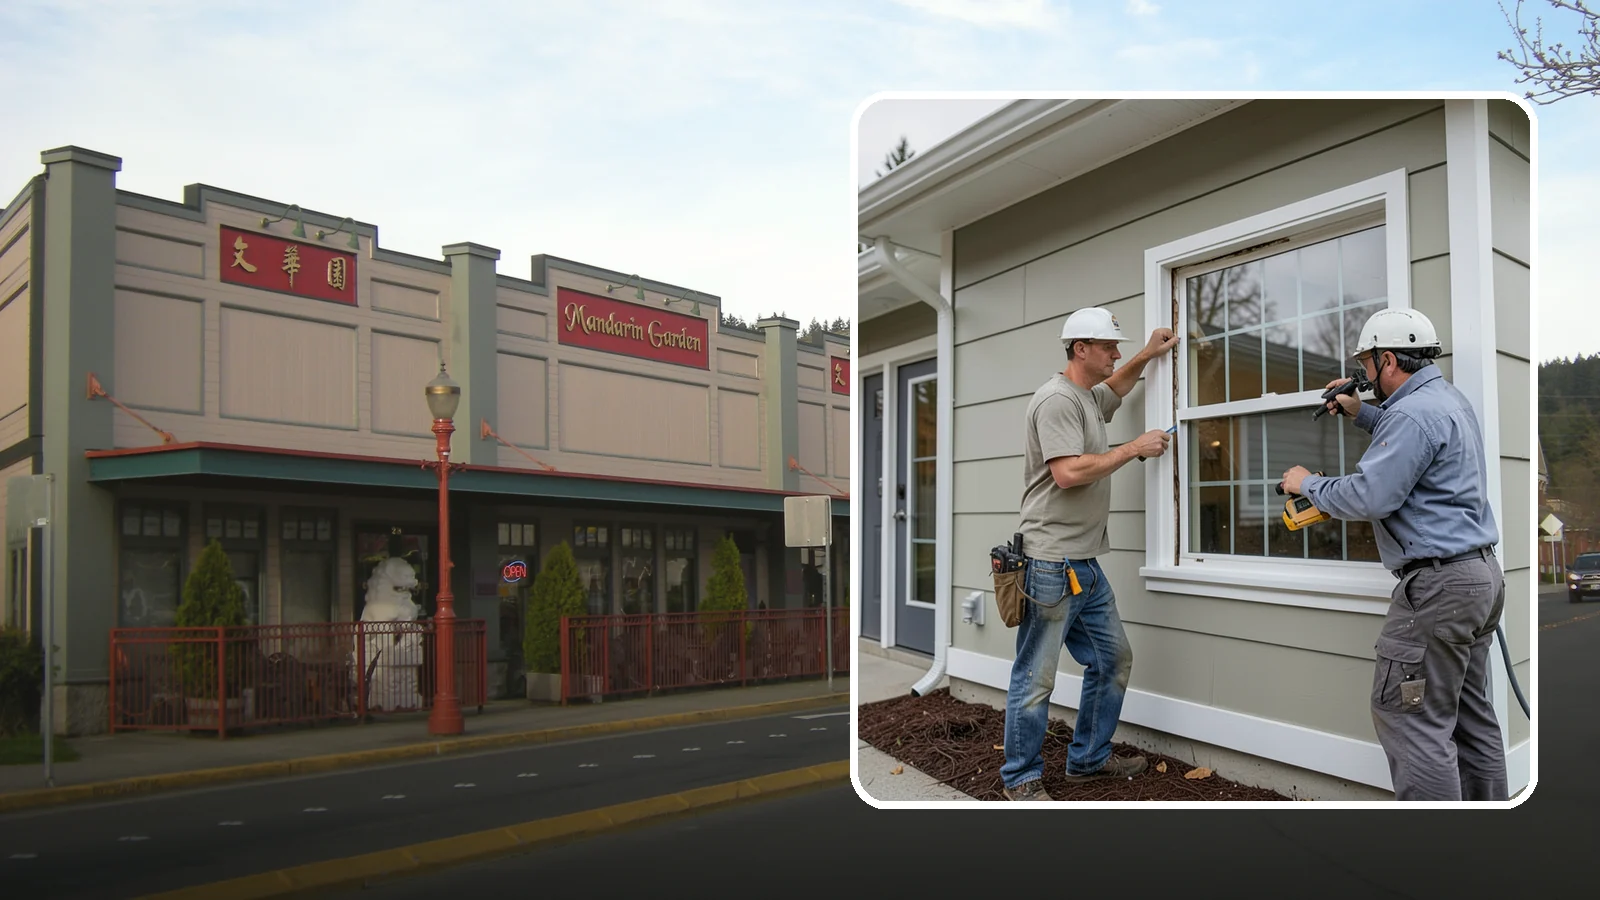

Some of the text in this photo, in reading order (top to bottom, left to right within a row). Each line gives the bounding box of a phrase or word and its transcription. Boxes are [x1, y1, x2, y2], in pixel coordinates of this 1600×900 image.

[230, 235, 346, 290] 文華園
[564, 302, 702, 352] Mandarin Garden
[503, 565, 527, 578] OPEN
